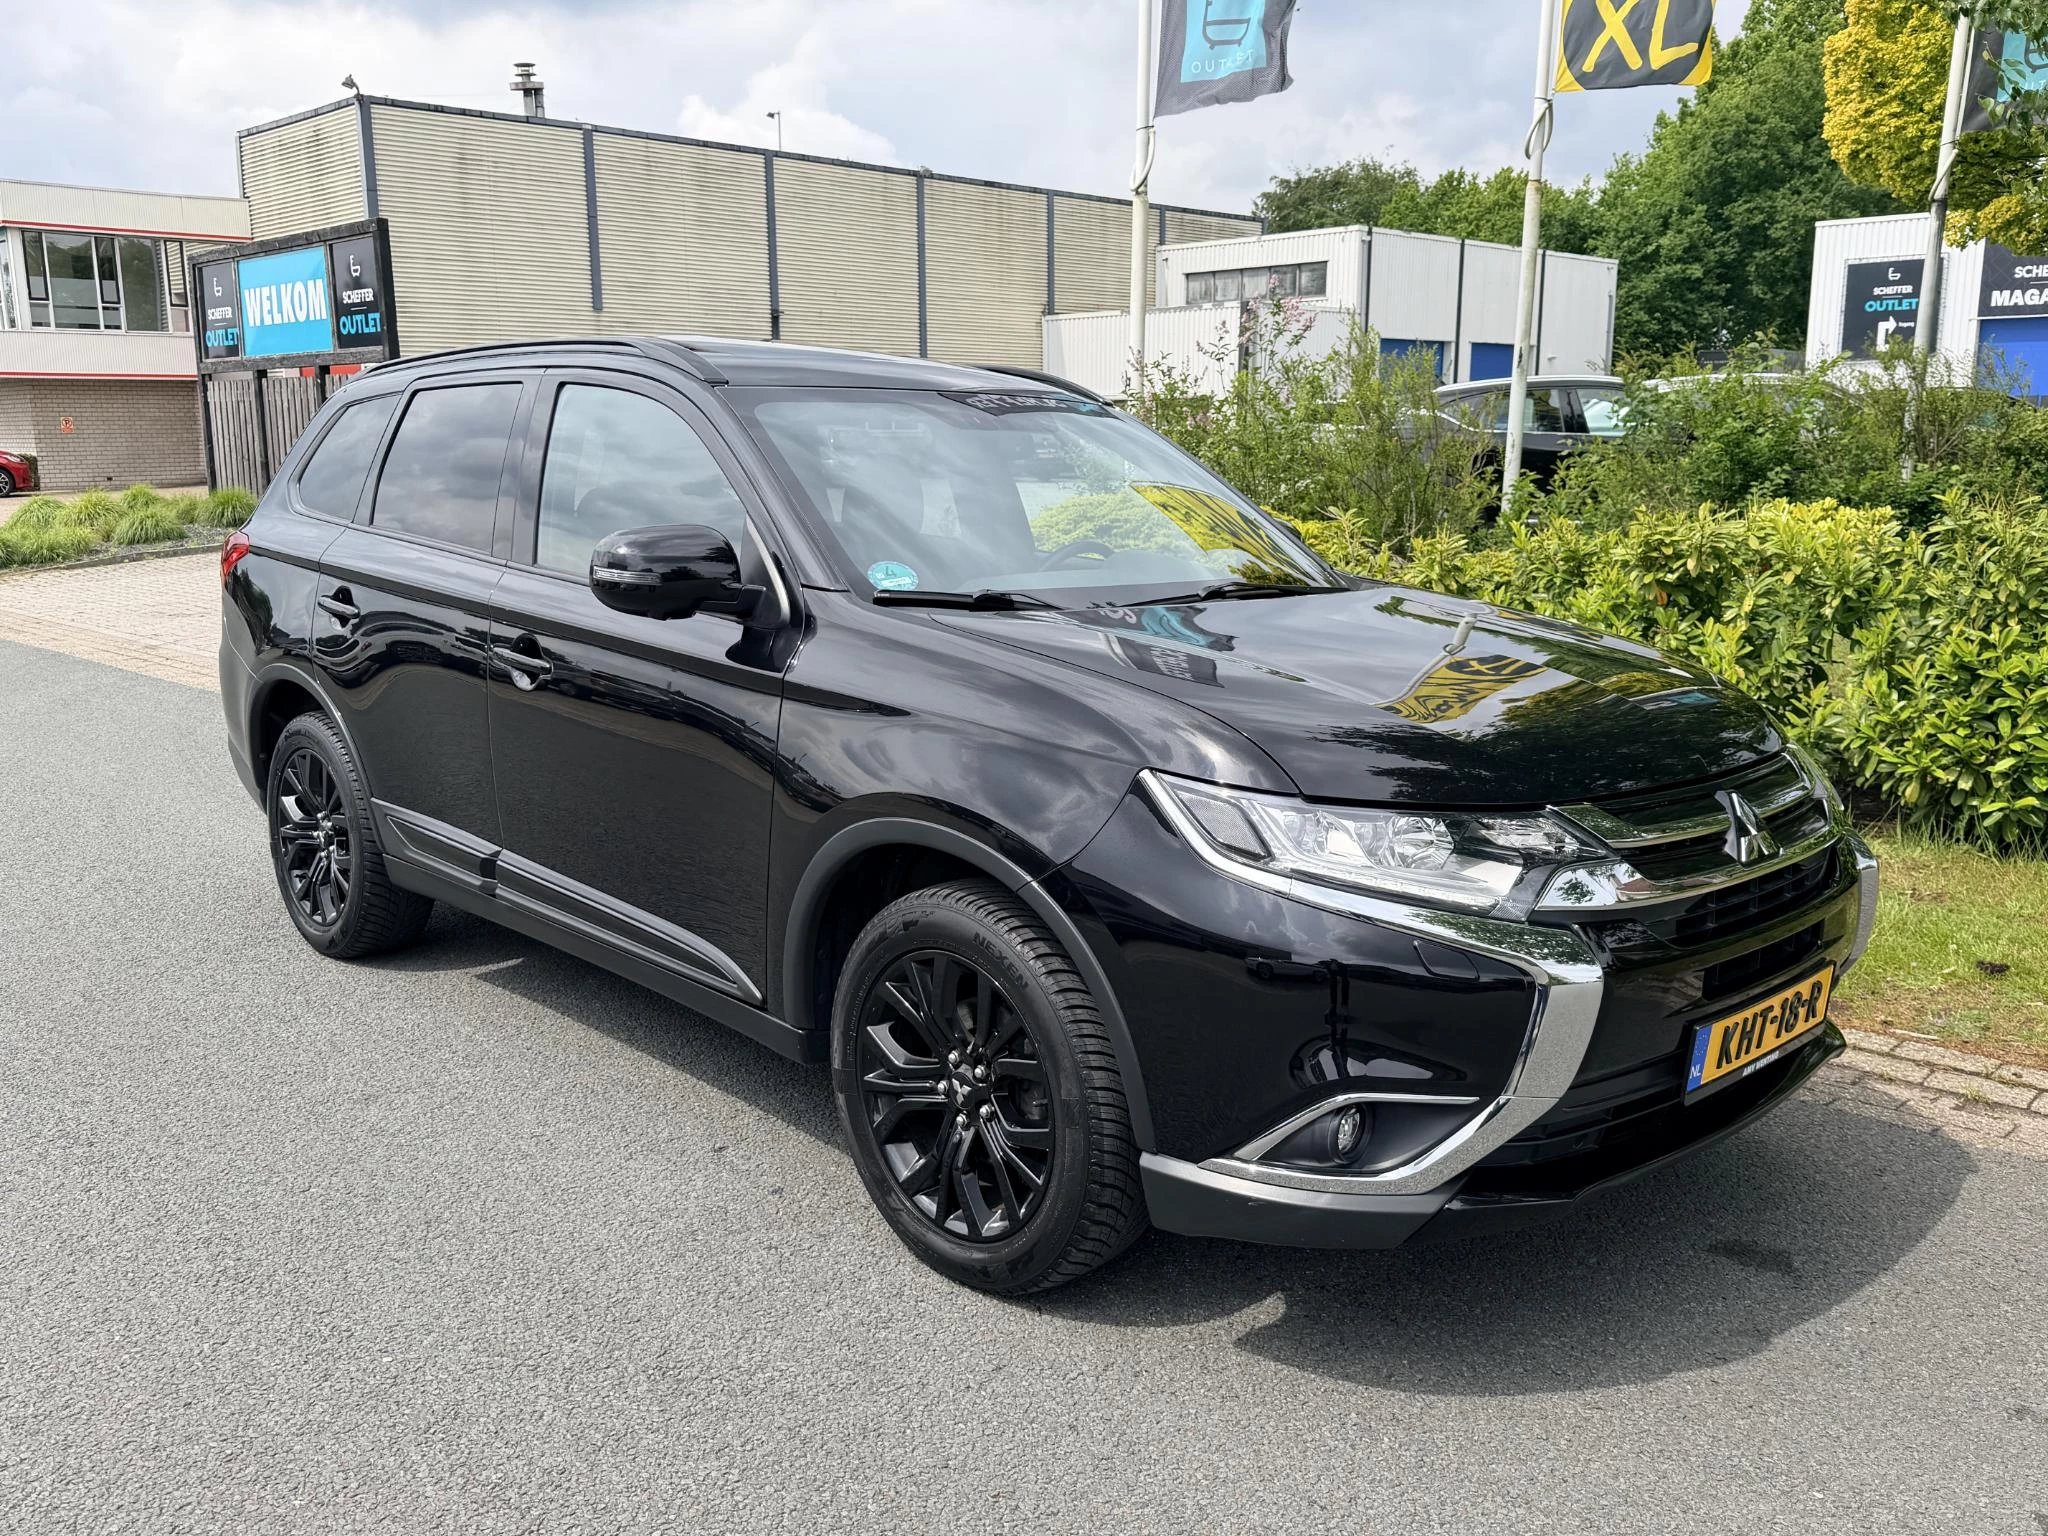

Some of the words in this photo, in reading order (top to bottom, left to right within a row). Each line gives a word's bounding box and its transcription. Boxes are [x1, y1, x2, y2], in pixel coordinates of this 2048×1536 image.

[1582, 0, 1699, 72] XL
[342, 288, 374, 304] SCHEFFER
[1873, 285, 1913, 296] SCHEFFER
[244, 278, 327, 327] WELKOM
[1864, 298, 1919, 313] OUTLET
[207, 306, 233, 320] SCHEFFER
[339, 312, 382, 335] OUTLET
[205, 327, 239, 347] OUTLET
[974, 931, 1029, 991] NEXEN
[1716, 980, 1823, 1070] KHT-18-R
[1689, 1065, 1702, 1080] NL
